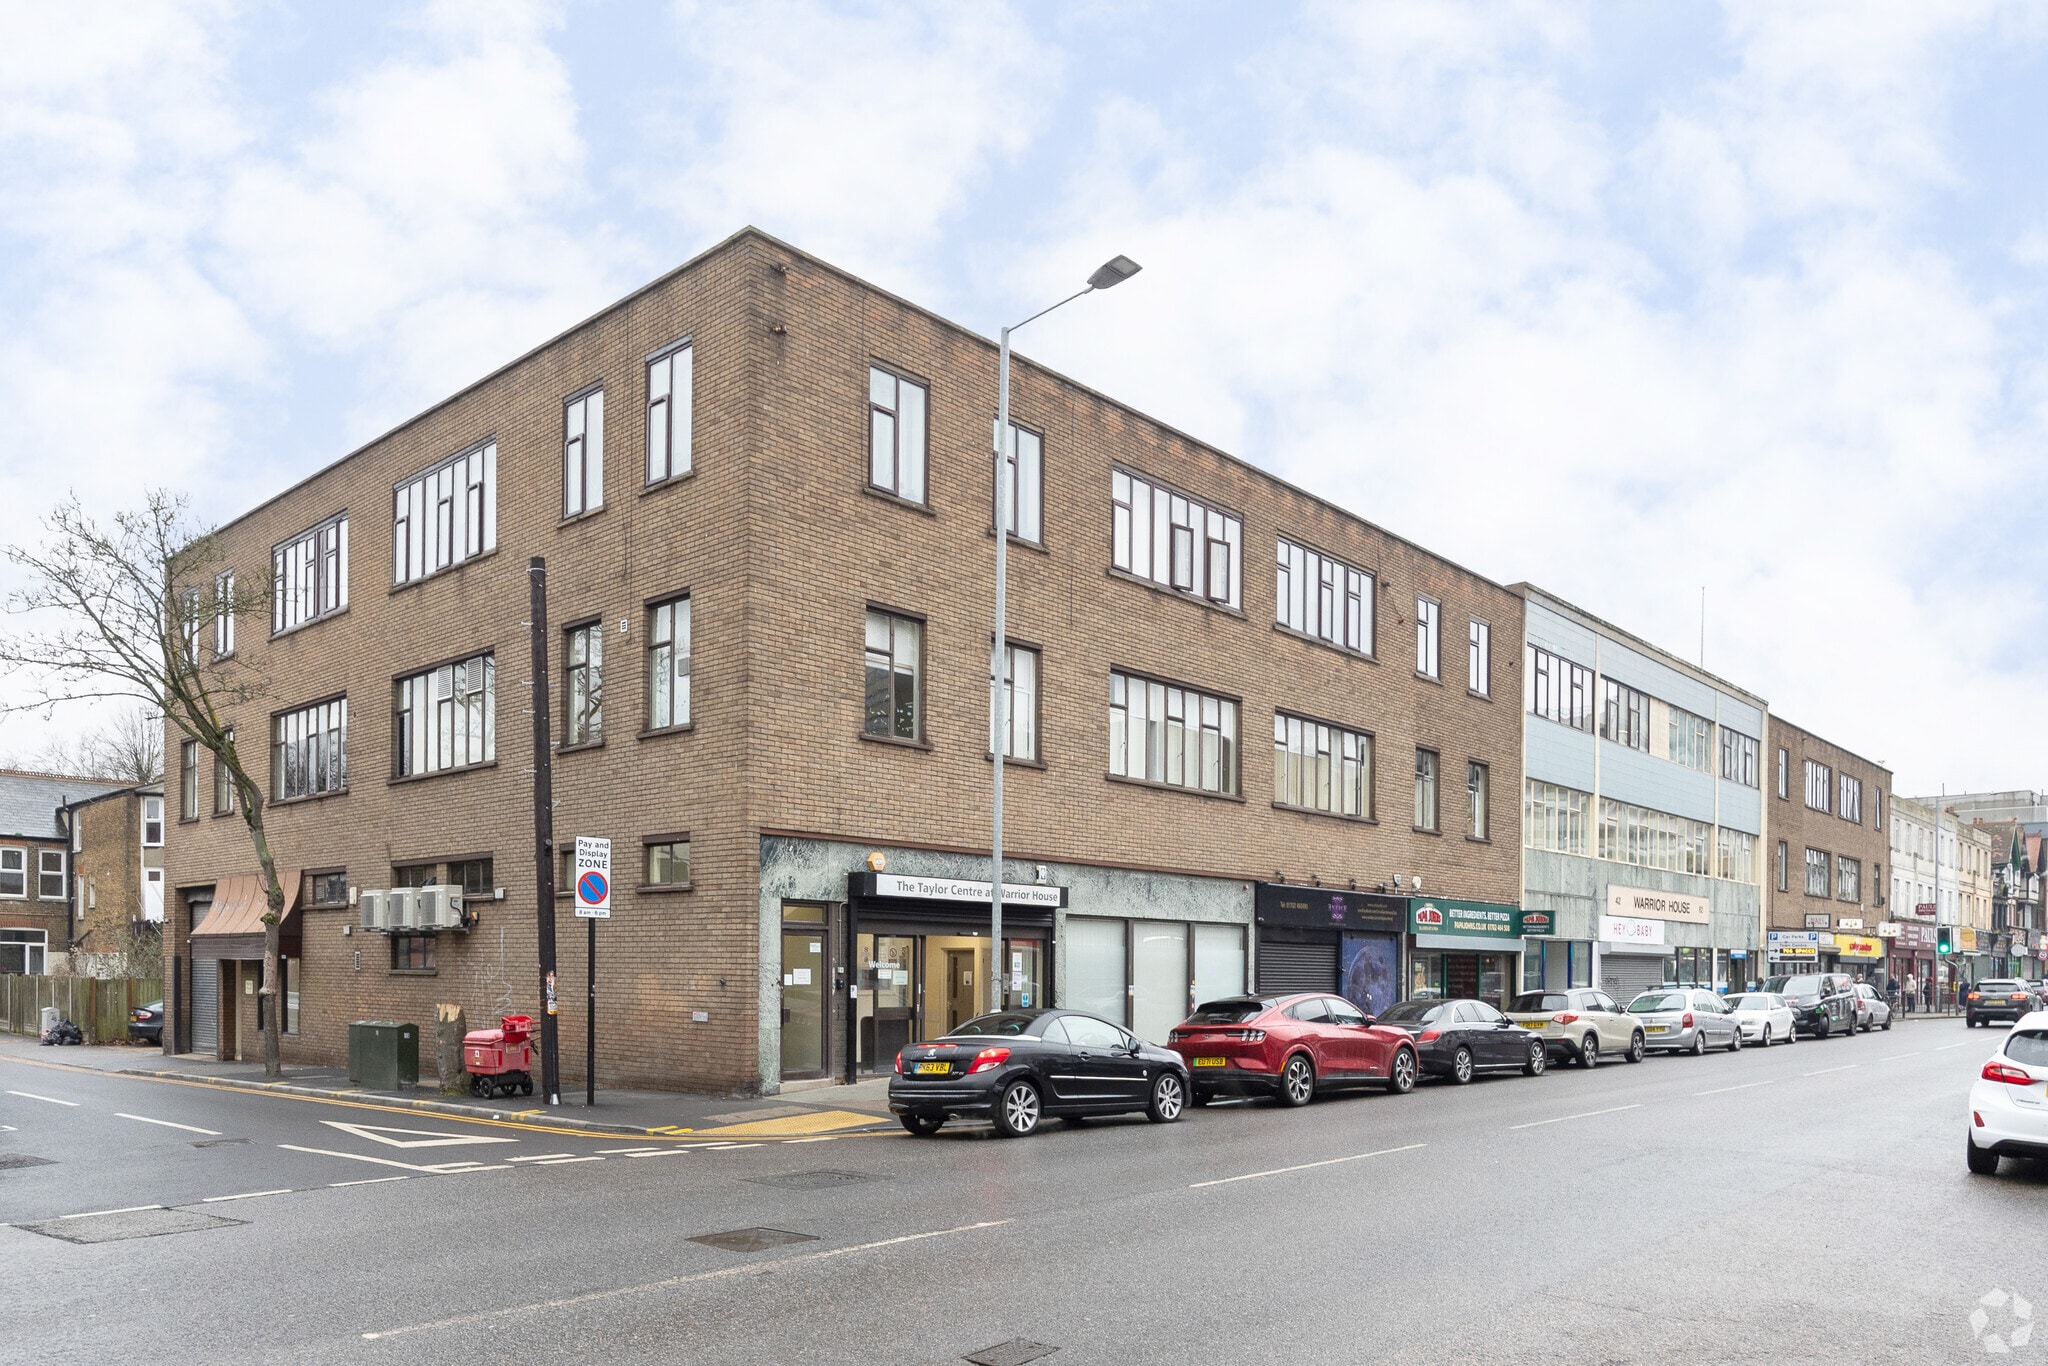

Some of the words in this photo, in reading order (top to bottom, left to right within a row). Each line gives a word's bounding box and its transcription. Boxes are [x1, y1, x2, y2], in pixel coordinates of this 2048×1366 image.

[578, 839, 592, 849] Pay
[579, 849, 608, 859] Display
[578, 858, 608, 869] ZONE
[896, 880, 915, 892] The
[918, 882, 948, 896] Taylor
[951, 885, 983, 897] Centre
[1032, 891, 1058, 902] House
[1633, 896, 1666, 911] WARRIOR
[1668, 901, 1691, 914] HOUSE
[1417, 909, 1428, 923] PAPA
[1449, 908, 1463, 918] BETTER
[1487, 911, 1500, 920] BETTER
[1500, 912, 1510, 921] PIZZA
[1613, 923, 1626, 935] HEY
[1637, 925, 1653, 937] BABY
[868, 960, 900, 969] Welcome
